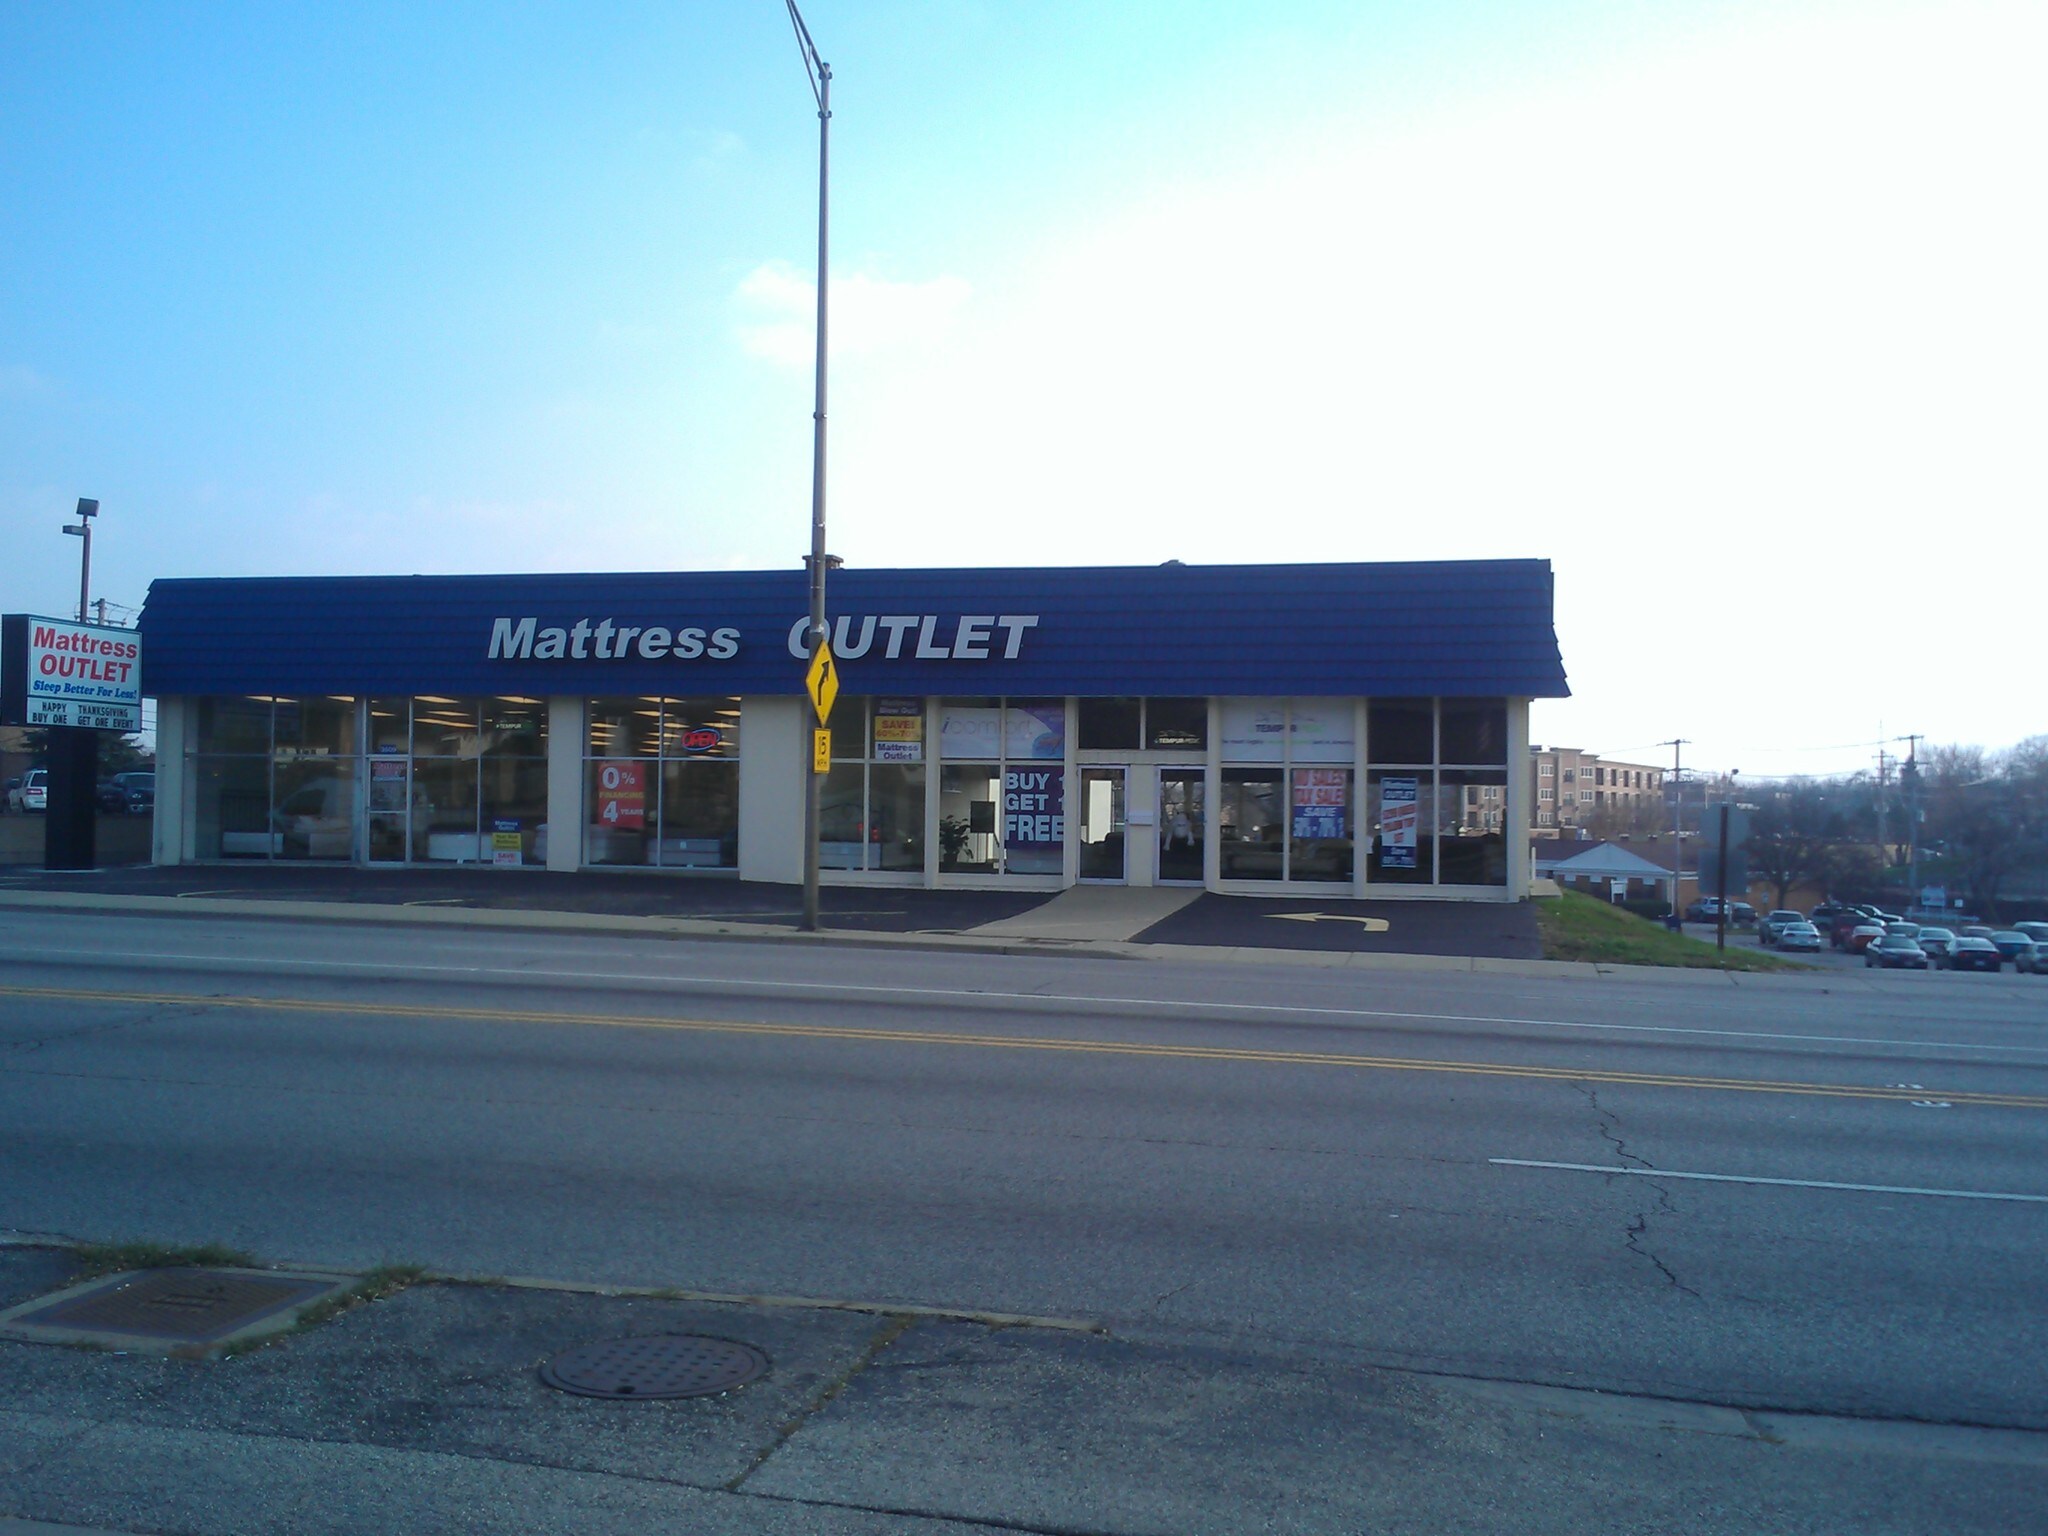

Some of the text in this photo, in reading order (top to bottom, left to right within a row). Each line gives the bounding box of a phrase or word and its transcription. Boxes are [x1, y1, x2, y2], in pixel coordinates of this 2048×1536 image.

[33, 626, 138, 659] Mattress
[488, 614, 1039, 660] Mattress OUTLET
[39, 653, 132, 683] OUTLET
[33, 680, 137, 699] Sleep Better For Less!
[42, 702, 129, 717] HAPPY THANKSGIVING
[32, 712, 134, 728] BUY ONE GET ONE EVENT
[681, 731, 718, 747] OPEN
[877, 743, 919, 752] Mattress
[883, 751, 912, 760] Outlet
[1005, 772, 1050, 790] BUY
[599, 791, 645, 800] FINANCING
[1005, 793, 1050, 811] GET
[603, 800, 619, 823] 4
[1303, 806, 1338, 818] SAVE
[1005, 814, 1064, 842] FREE
